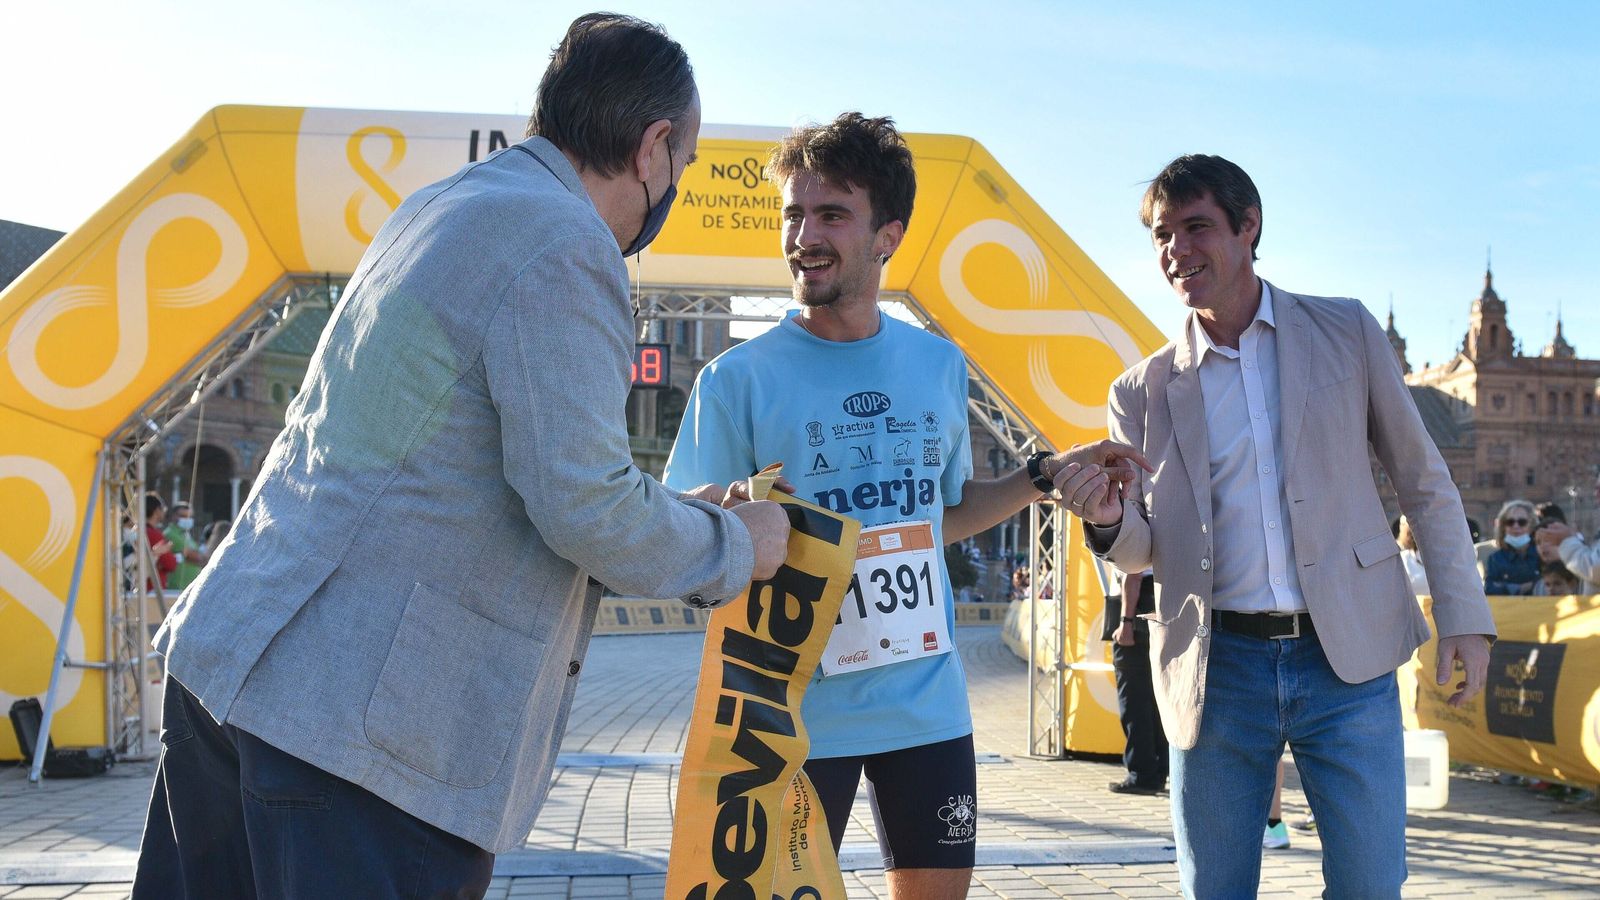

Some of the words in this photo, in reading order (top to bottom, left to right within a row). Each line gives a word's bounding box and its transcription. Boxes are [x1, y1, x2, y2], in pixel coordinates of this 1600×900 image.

[844, 393, 890, 413] TROPS
[846, 420, 875, 432] activa
[814, 468, 935, 516] nerja
[836, 561, 934, 625] 1391
[800, 832, 808, 849] de
[947, 825, 974, 837] NERJA
[788, 819, 802, 872] Instituto
